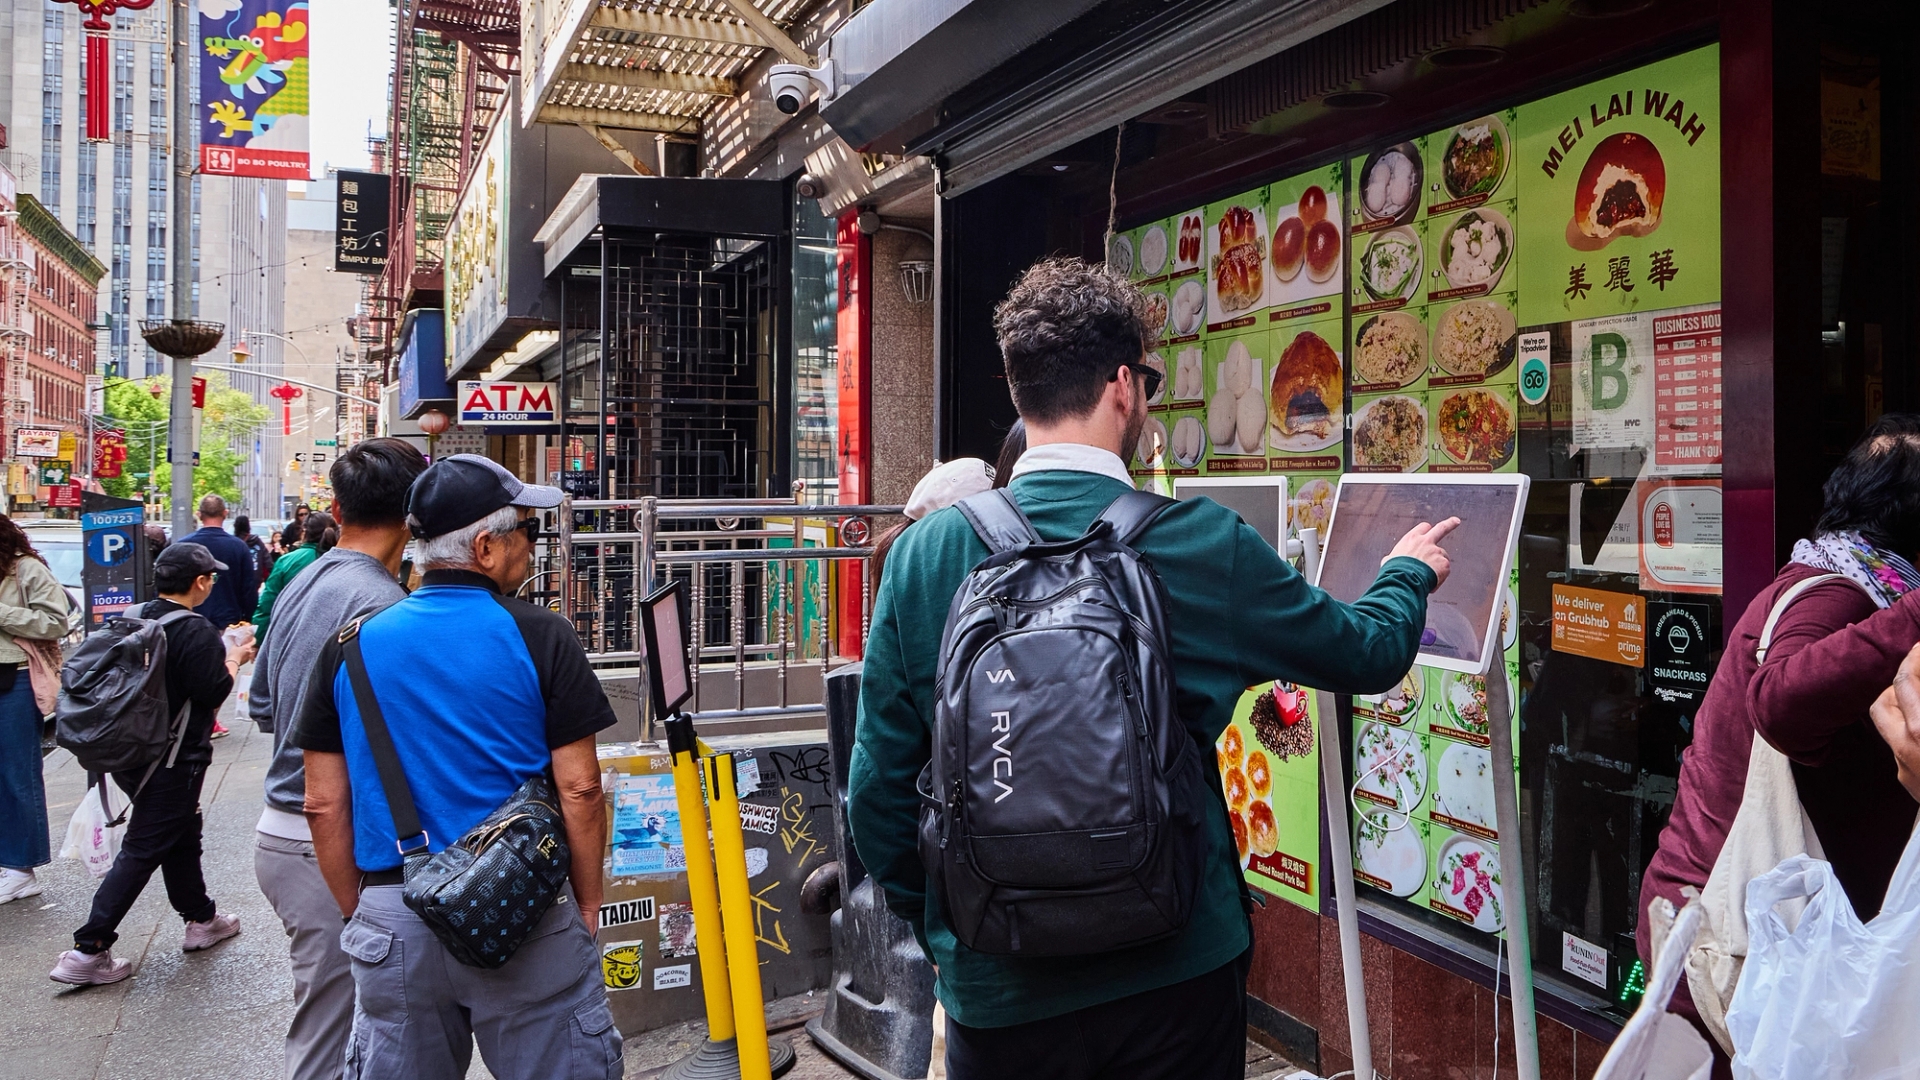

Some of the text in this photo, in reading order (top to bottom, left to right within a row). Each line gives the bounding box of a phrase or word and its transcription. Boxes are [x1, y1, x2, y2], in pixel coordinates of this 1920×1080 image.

[1542, 89, 1706, 179] MEI LAI WAH
[268, 160, 307, 168] POULTRY
[339, 254, 370, 264] SIMPLY
[1565, 248, 1679, 300] 美麗華
[1655, 316, 1699, 334] BUSINESS
[1521, 344, 1548, 353] Tripadvisor
[1592, 332, 1628, 410] B
[463, 385, 553, 411] ATM
[1674, 446, 1701, 458] THANK
[93, 516, 133, 525] 100723
[103, 534, 125, 562] P
[94, 596, 132, 605] 100723
[1555, 594, 1604, 612] We deliver
[1555, 612, 1609, 629] on Grubhub
[1618, 621, 1642, 632] GRUBHUB
[1656, 615, 1666, 637] ORDER
[1666, 608, 1684, 618] AHEAD
[1689, 615, 1703, 641] PICKUP
[1618, 641, 1641, 654] prime
[1654, 667, 1707, 682] SNACKPASS
[991, 711, 1013, 804] RVCA
[1257, 861, 1306, 889] Baked Roast Pork Bun
[600, 899, 653, 926] TADZIU
[1570, 945, 1605, 966] RUNIN Out
